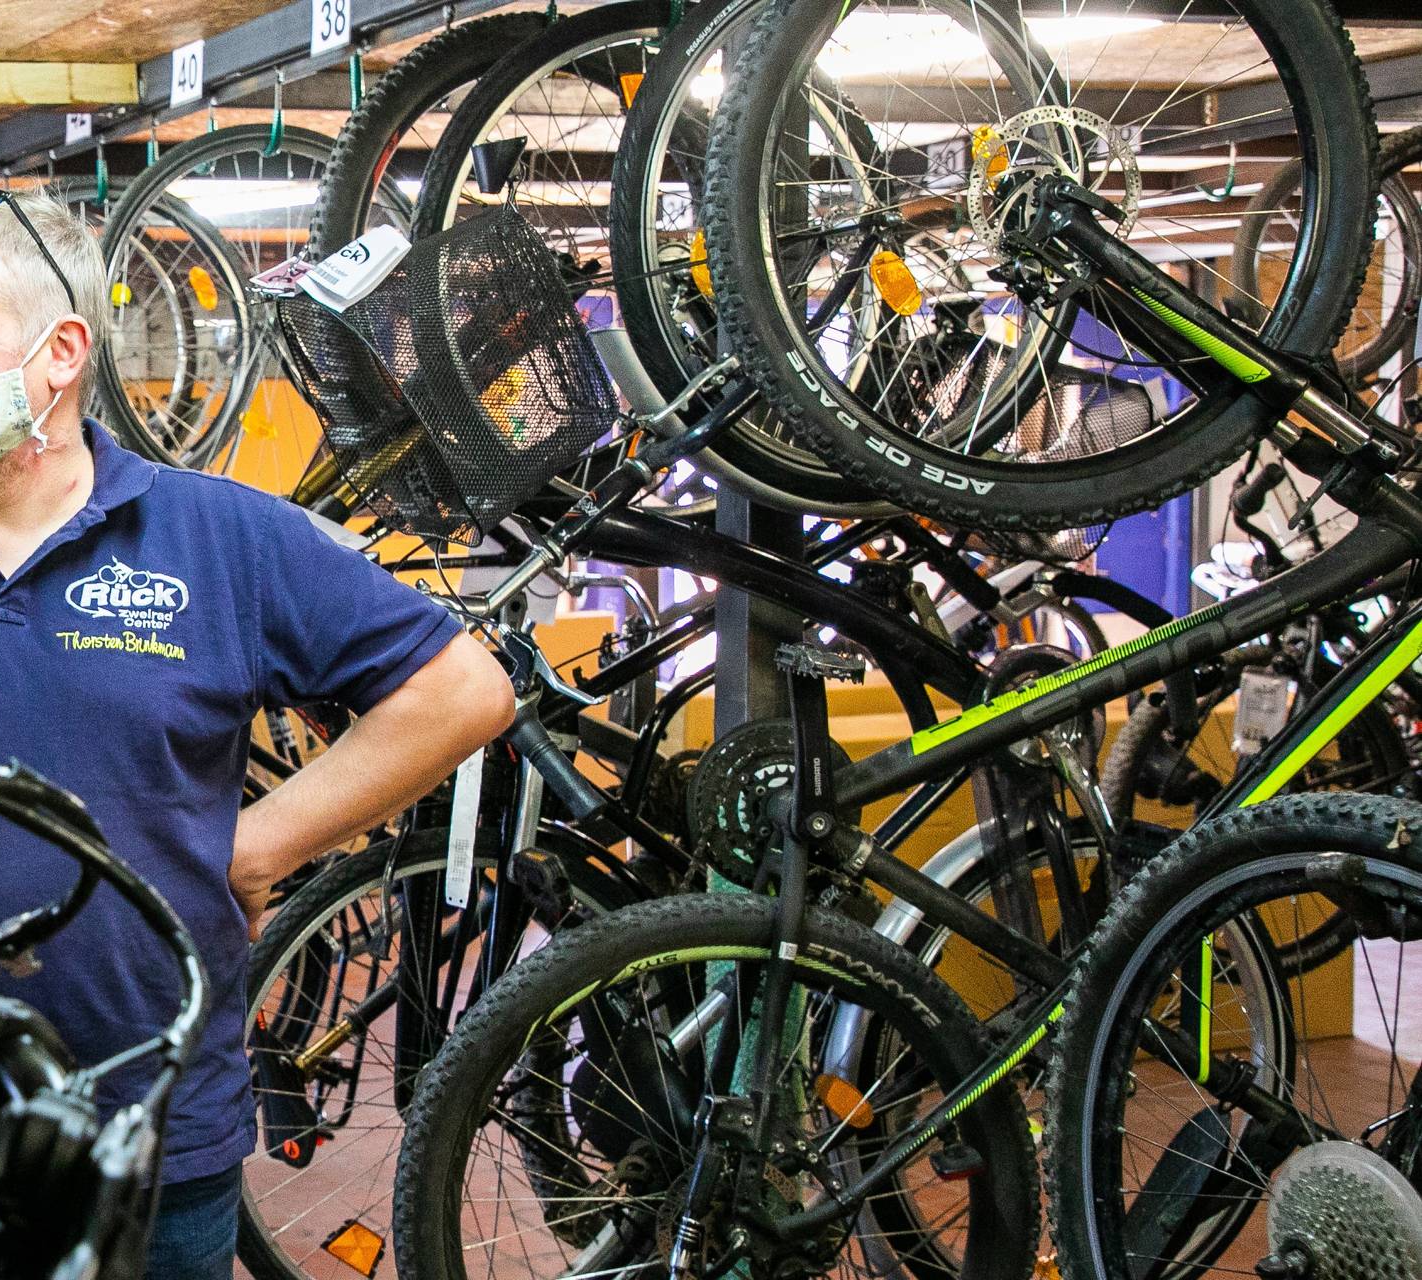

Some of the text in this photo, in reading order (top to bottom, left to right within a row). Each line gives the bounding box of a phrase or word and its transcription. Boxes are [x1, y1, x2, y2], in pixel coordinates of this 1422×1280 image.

[321, 0, 346, 41] 38
[178, 53, 197, 92] 40
[786, 349, 996, 496] ACE OF PACE
[80, 582, 179, 607] Rück
[123, 618, 171, 630] Center
[56, 630, 125, 651] Thorsten
